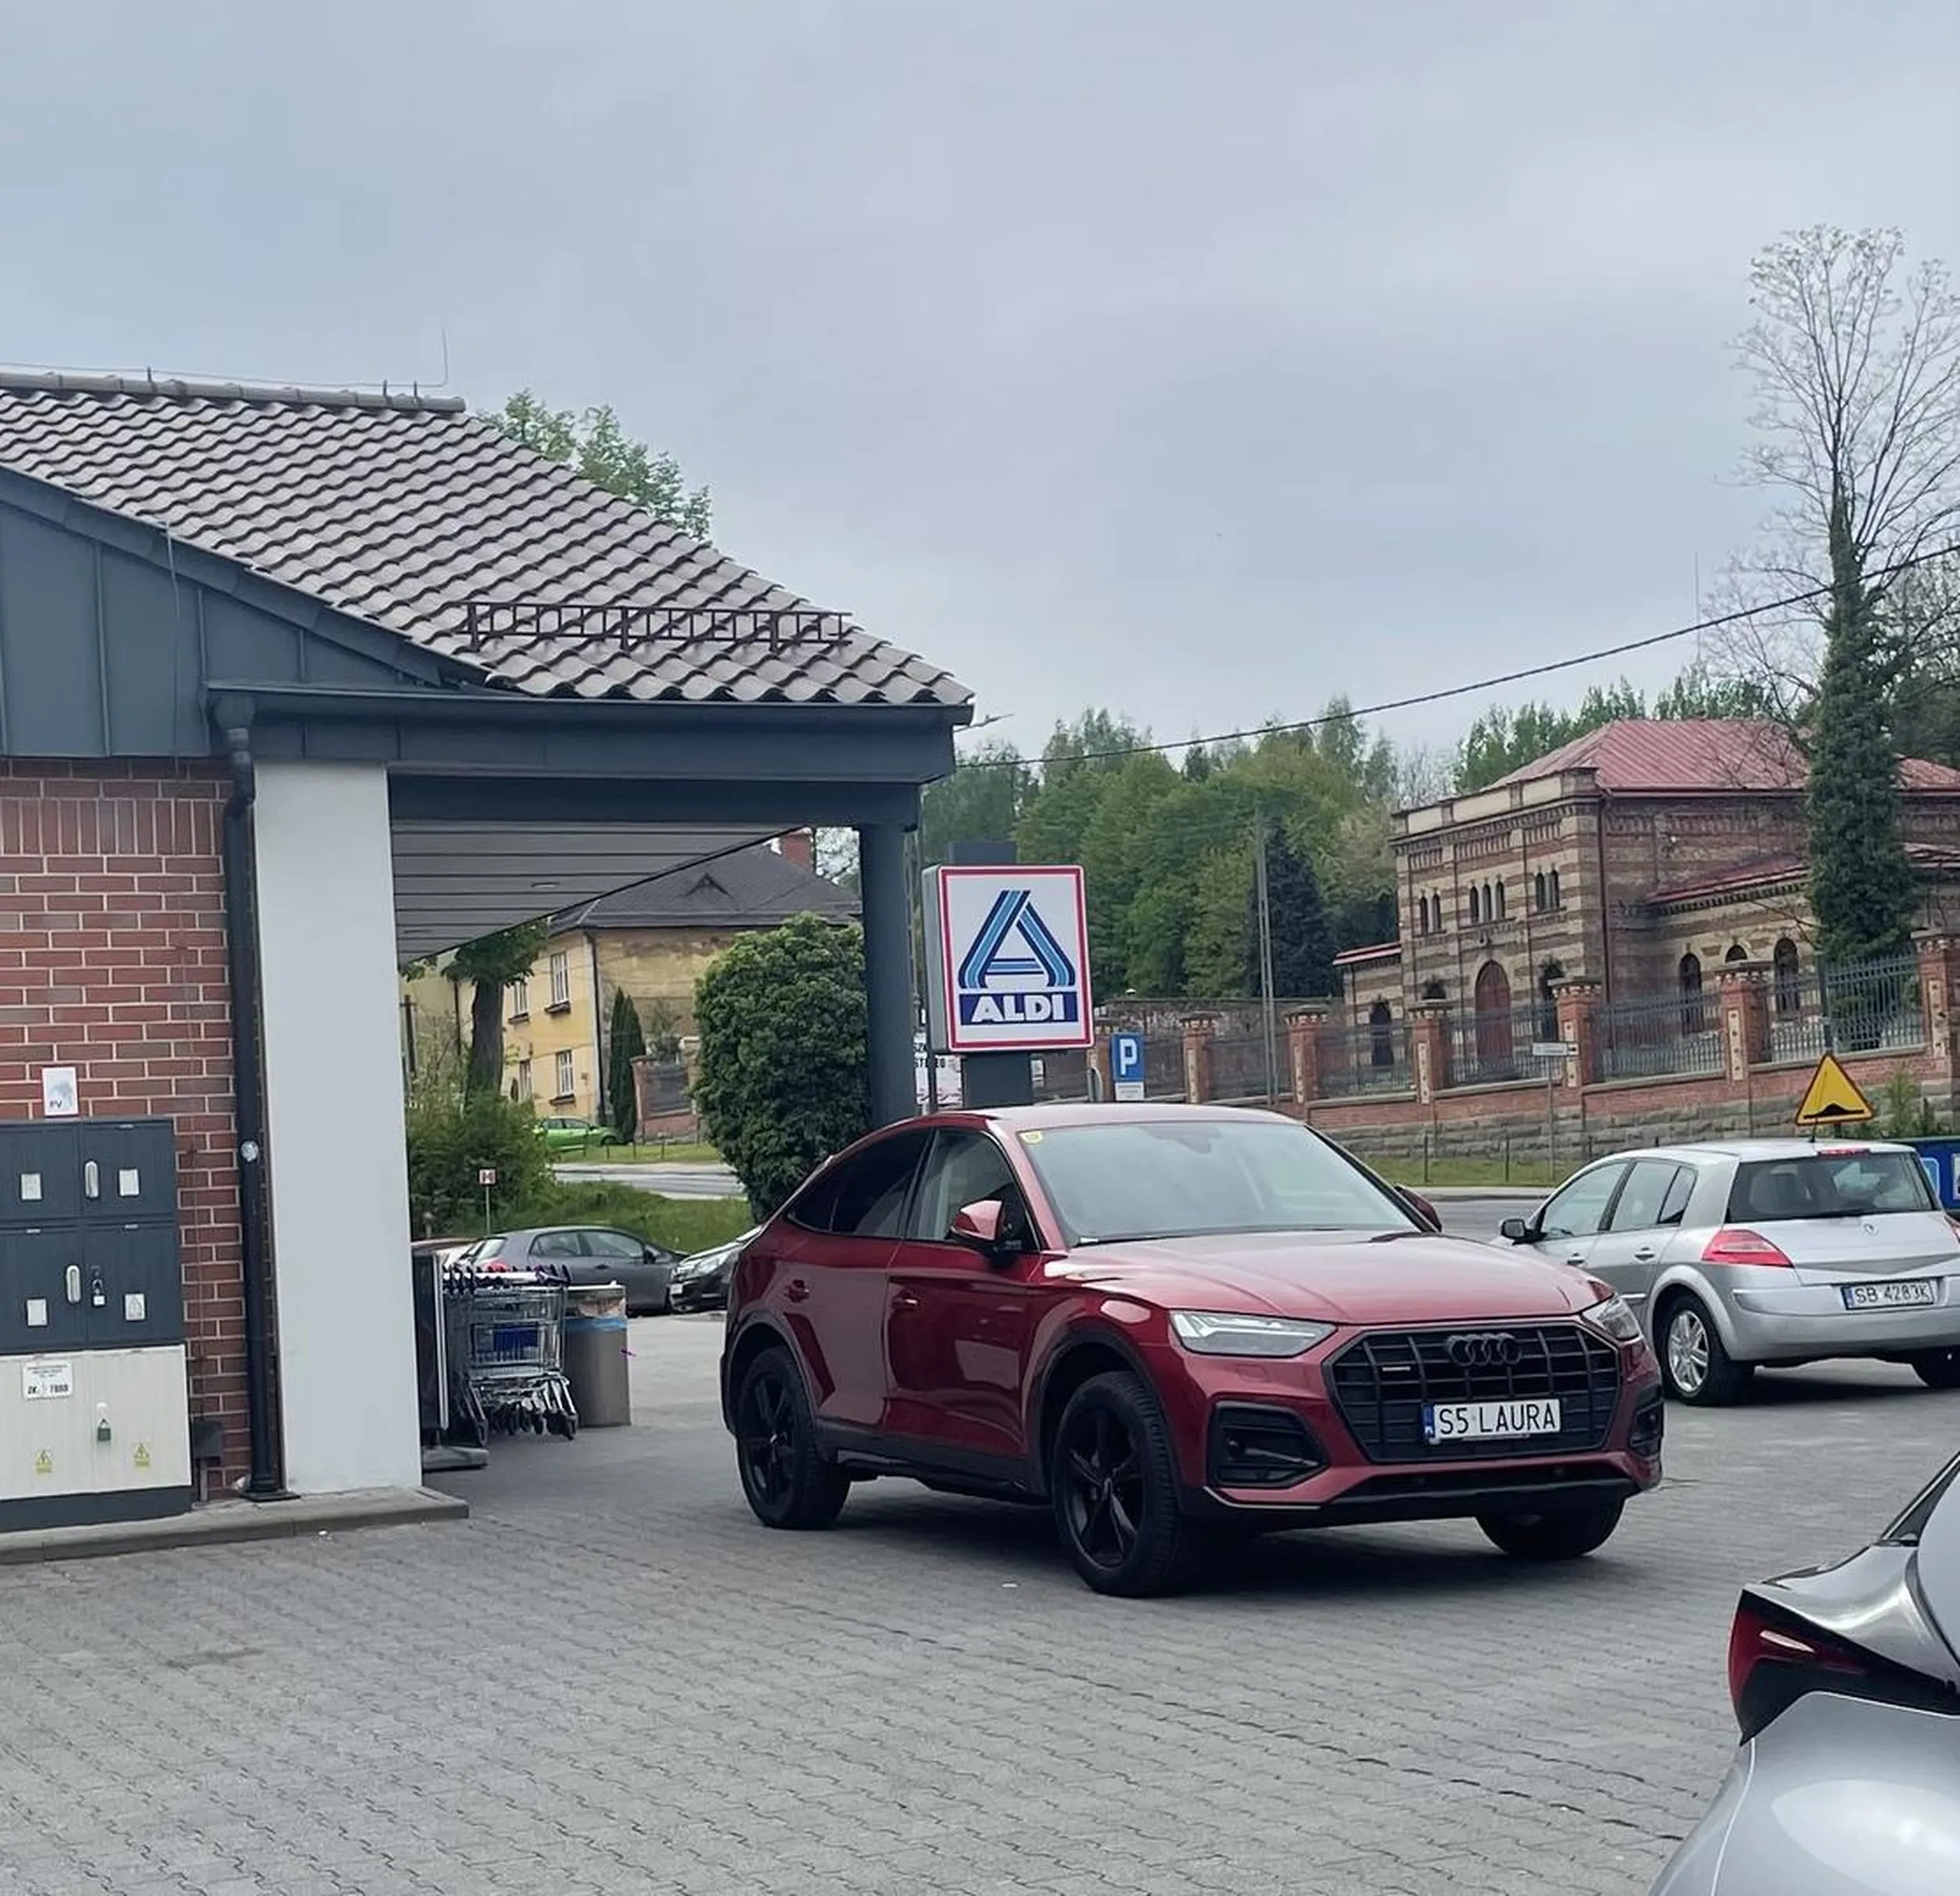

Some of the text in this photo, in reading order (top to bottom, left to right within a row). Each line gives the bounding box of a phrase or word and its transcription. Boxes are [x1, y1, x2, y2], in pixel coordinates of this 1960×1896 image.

[971, 994, 1065, 1023] ALDI
[1120, 1038, 1138, 1075] P
[1854, 1286, 1878, 1303] SB
[1439, 1401, 1557, 1435] S5 LAURA
